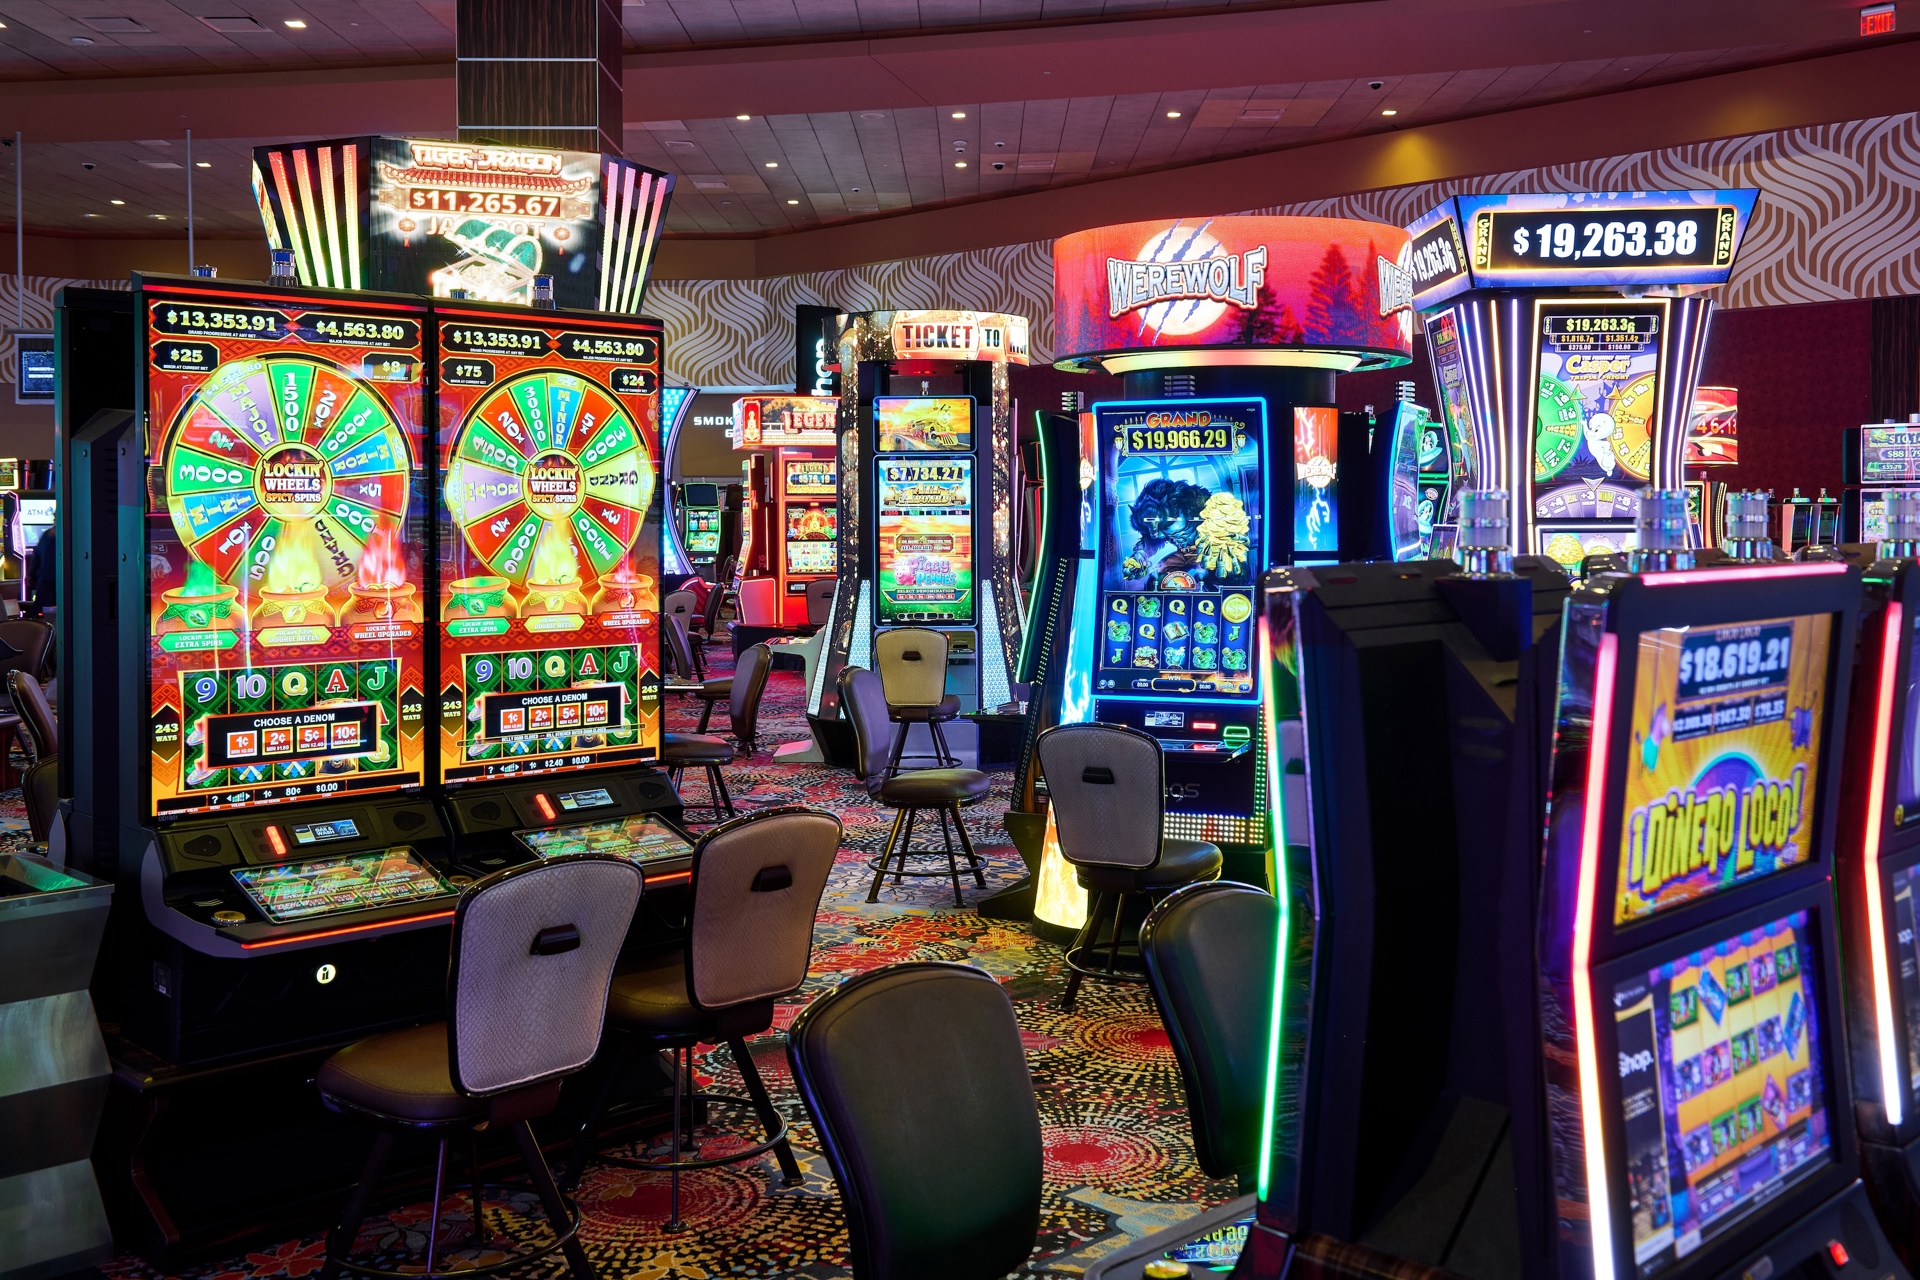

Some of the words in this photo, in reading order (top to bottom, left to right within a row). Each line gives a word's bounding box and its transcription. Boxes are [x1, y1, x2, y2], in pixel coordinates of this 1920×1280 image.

[1866, 12, 1892, 35] EXIT
[411, 144, 474, 168] TIGER
[477, 150, 564, 175] DRAGON
[412, 190, 558, 217] $11,265.67
[427, 214, 546, 240] JAPOT
[1476, 218, 1489, 265] GRAND
[1513, 220, 1698, 261] $19,263.38
[1717, 213, 1734, 260] GRAND
[1107, 245, 1268, 318] WEREWOLF
[167, 310, 277, 332] $13,353.91
[316, 320, 404, 340] $4,563.80
[453, 329, 541, 349] $13,353.91
[902, 324, 973, 349] TICKET
[984, 328, 1000, 348] TO
[170, 348, 204, 362] $25
[572, 339, 645, 356] $4,563.80
[382, 360, 401, 373] $8
[456, 364, 483, 378] $75
[1565, 354, 1631, 378] Casper
[622, 374, 645, 387] $24
[284, 372, 299, 432] 1500
[227, 382, 276, 447] MAJOR
[523, 386, 547, 443] 30000
[556, 389, 571, 445] MINOR
[1146, 411, 1212, 428] GRAND
[585, 425, 628, 463] 3000
[1132, 430, 1227, 451] $19,966.29
[334, 442, 390, 472] MINOR
[472, 434, 519, 468] 4500
[179, 464, 244, 485] 3000
[589, 469, 639, 486] GRAND
[889, 467, 959, 481] $7,734.27
[1296, 462, 1338, 480] WEREWOLF
[264, 477, 322, 491] WHEELS
[464, 482, 520, 502] MAJOR
[531, 480, 577, 493] WHEELS
[265, 492, 294, 503] SPICY
[294, 492, 322, 503] SPINS
[531, 494, 554, 503] SPICY
[554, 494, 577, 503] SPINS
[26, 509, 44, 517] ATM
[188, 495, 252, 527] MINI
[577, 517, 613, 561] 1500
[314, 518, 356, 579] GRAND
[249, 536, 276, 581] 500
[1112, 599, 1128, 616] Q
[1168, 599, 1186, 616] Q
[1198, 600, 1215, 616] Q
[621, 618, 650, 626] UPGRADES
[377, 630, 412, 638] UPGRADES
[1139, 623, 1156, 640] Q
[1228, 625, 1241, 642] J
[175, 641, 200, 649] EXTRA
[579, 653, 599, 676] A
[612, 650, 630, 673] J
[1111, 648, 1124, 664] J
[1679, 636, 1790, 684] $18,619.21
[475, 659, 493, 683] 9
[507, 657, 532, 680] 10
[544, 655, 565, 677] Q
[235, 674, 267, 699] 10
[281, 671, 308, 697] Q
[324, 668, 350, 694] A
[367, 666, 388, 691] J
[195, 677, 218, 703] 9
[641, 685, 658, 694] 243
[642, 693, 657, 701] WAYS
[442, 700, 462, 710] 243
[522, 695, 553, 705] CHOOSE
[562, 693, 588, 701] DENOM
[402, 703, 422, 714] 243
[402, 713, 421, 722] WAYS
[443, 710, 461, 718] WAYS
[155, 723, 179, 734] 243
[253, 716, 292, 728] CHOOSE
[294, 716, 302, 724] A
[303, 713, 335, 723] DENOM
[156, 734, 178, 742] WAYS
[270, 732, 286, 745] 2¢
[304, 729, 320, 742] 5¢
[335, 726, 356, 739] 10¢
[236, 736, 249, 748] 1¢
[544, 758, 564, 768] $2.40
[571, 755, 590, 765] $0.00
[263, 790, 272, 798] 1¢
[285, 787, 301, 796] 80¢
[316, 782, 338, 793] $0.00
